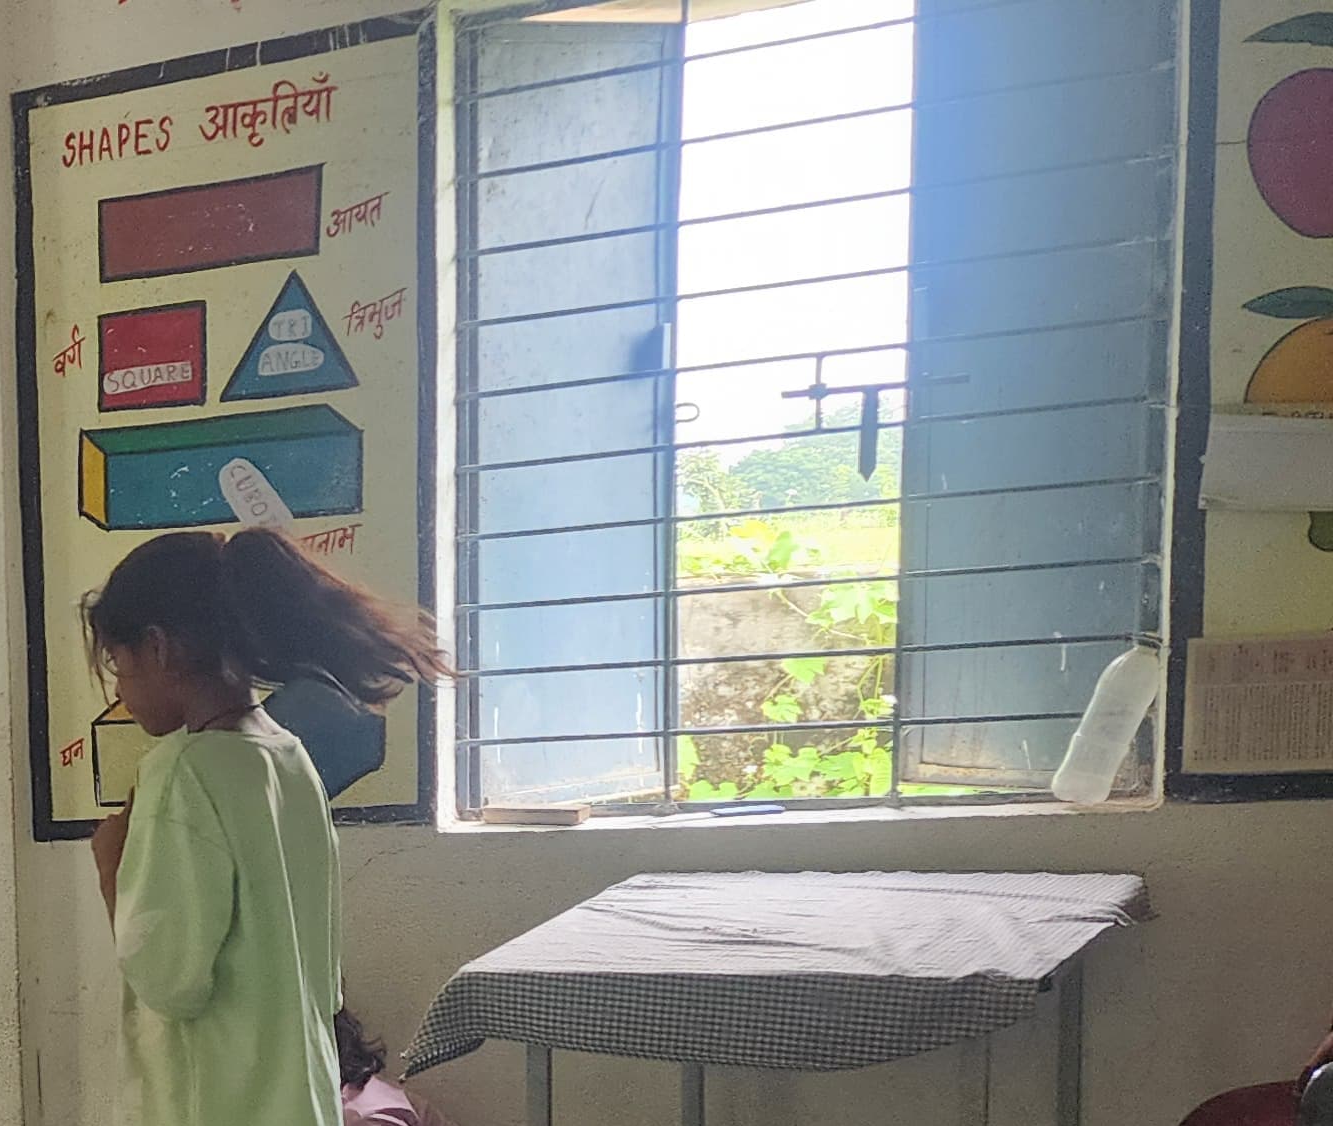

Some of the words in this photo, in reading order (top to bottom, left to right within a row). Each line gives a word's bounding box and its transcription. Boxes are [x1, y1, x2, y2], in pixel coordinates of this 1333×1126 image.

[61, 115, 175, 169] SHAPES
[325, 192, 391, 238] आयत
[51, 324, 87, 378] वर्ग
[105, 362, 193, 394] SQUARE
[59, 737, 86, 768] घन
